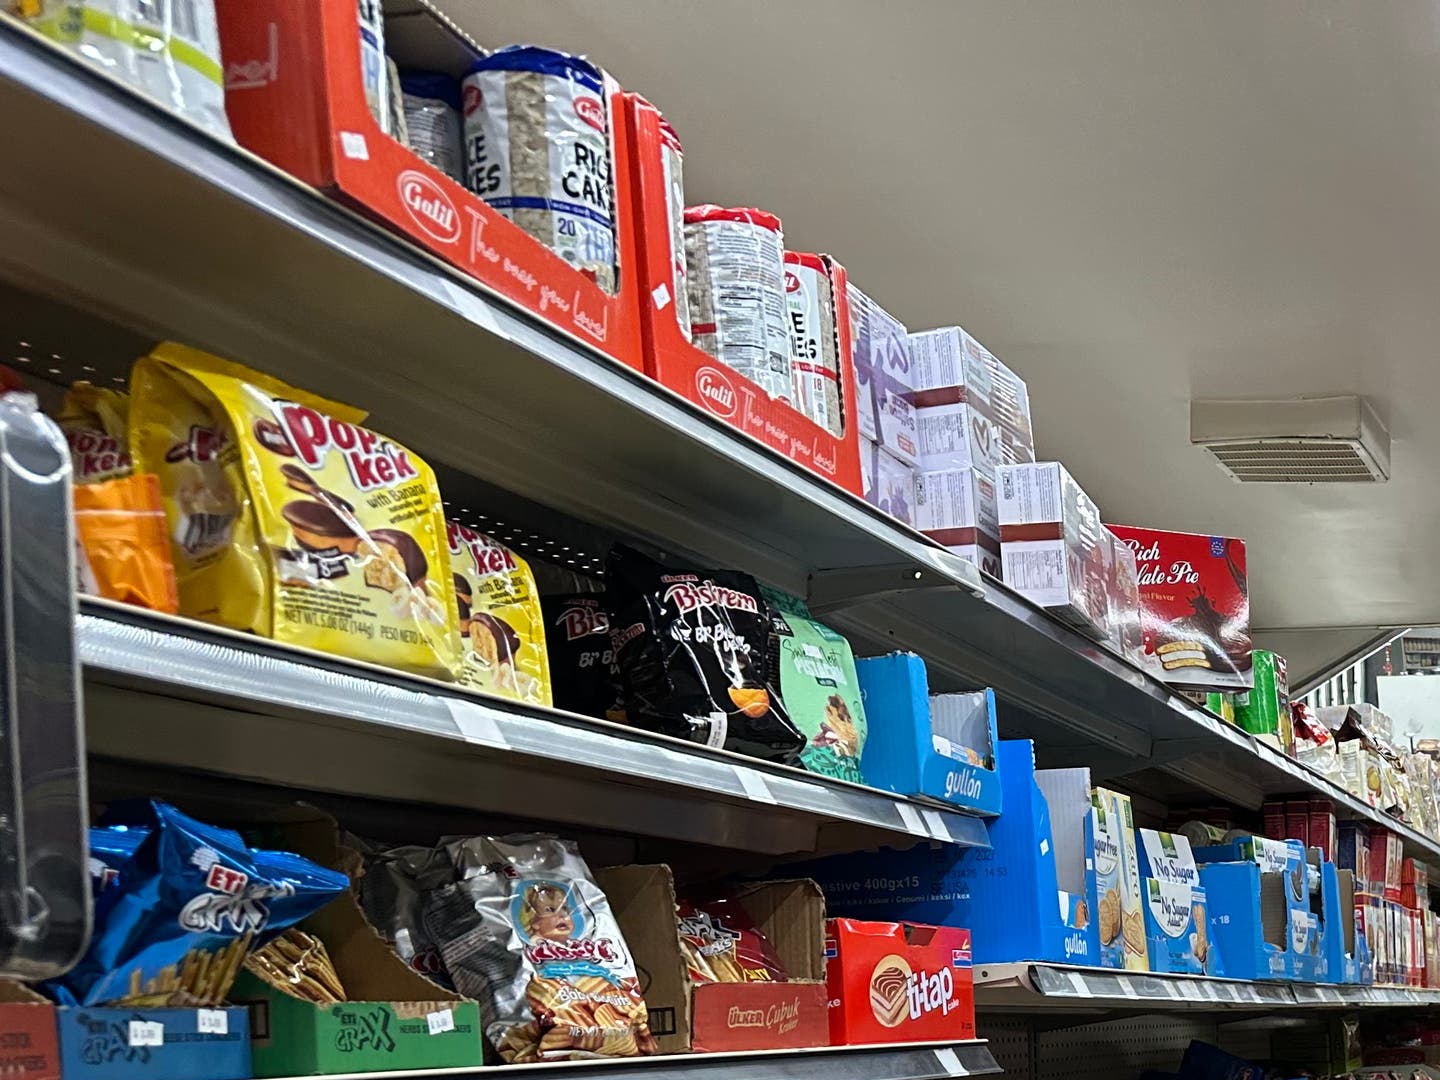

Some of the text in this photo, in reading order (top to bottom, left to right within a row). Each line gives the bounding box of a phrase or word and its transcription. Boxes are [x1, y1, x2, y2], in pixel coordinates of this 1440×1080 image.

[575, 142, 609, 180] RIC
[562, 172, 609, 209] CAK
[404, 181, 454, 232] Galil
[558, 217, 575, 237] 20
[699, 376, 732, 409] Galil
[367, 483, 427, 509] with Banana
[1167, 560, 1200, 584] Pie
[944, 769, 982, 801] gullón
[1153, 856, 1194, 884] No Sugar
[1161, 896, 1189, 921] No Sugar
[1064, 933, 1088, 957] gullón
[729, 1005, 764, 1028] ÜLKER
